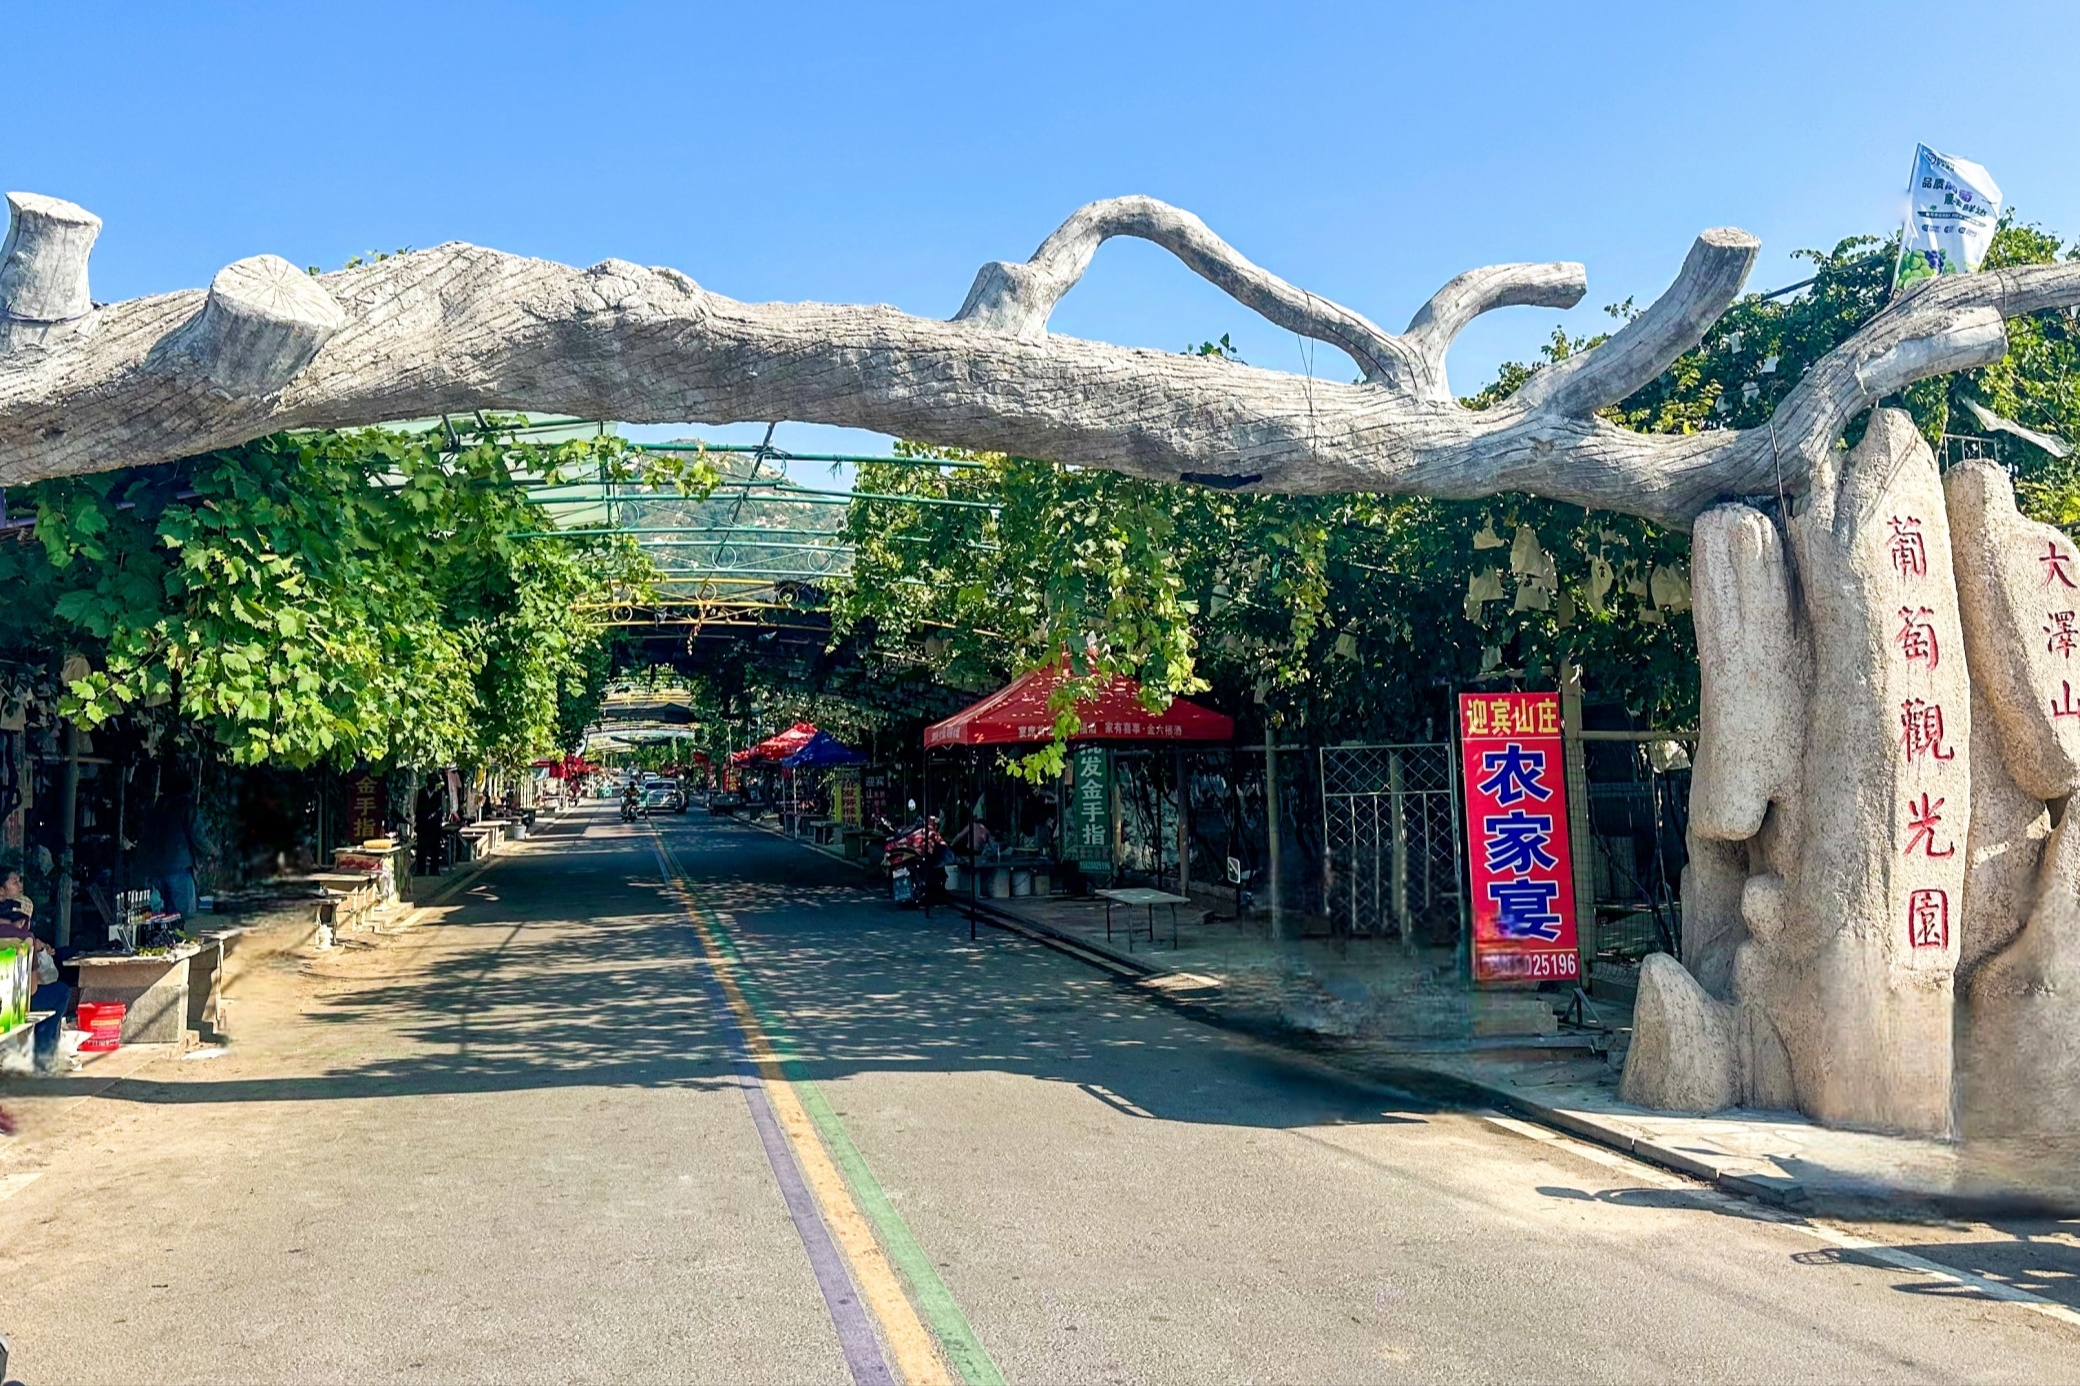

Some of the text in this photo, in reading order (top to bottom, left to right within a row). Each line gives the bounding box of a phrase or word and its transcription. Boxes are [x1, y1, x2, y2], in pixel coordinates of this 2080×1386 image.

[1466, 697, 1559, 736] 迎宾山庄
[2038, 540, 2080, 718] 大澤山
[353, 775, 379, 838] 金手指
[1885, 514, 1955, 951] 葡萄觀光園
[1477, 742, 1562, 942] 农家宴
